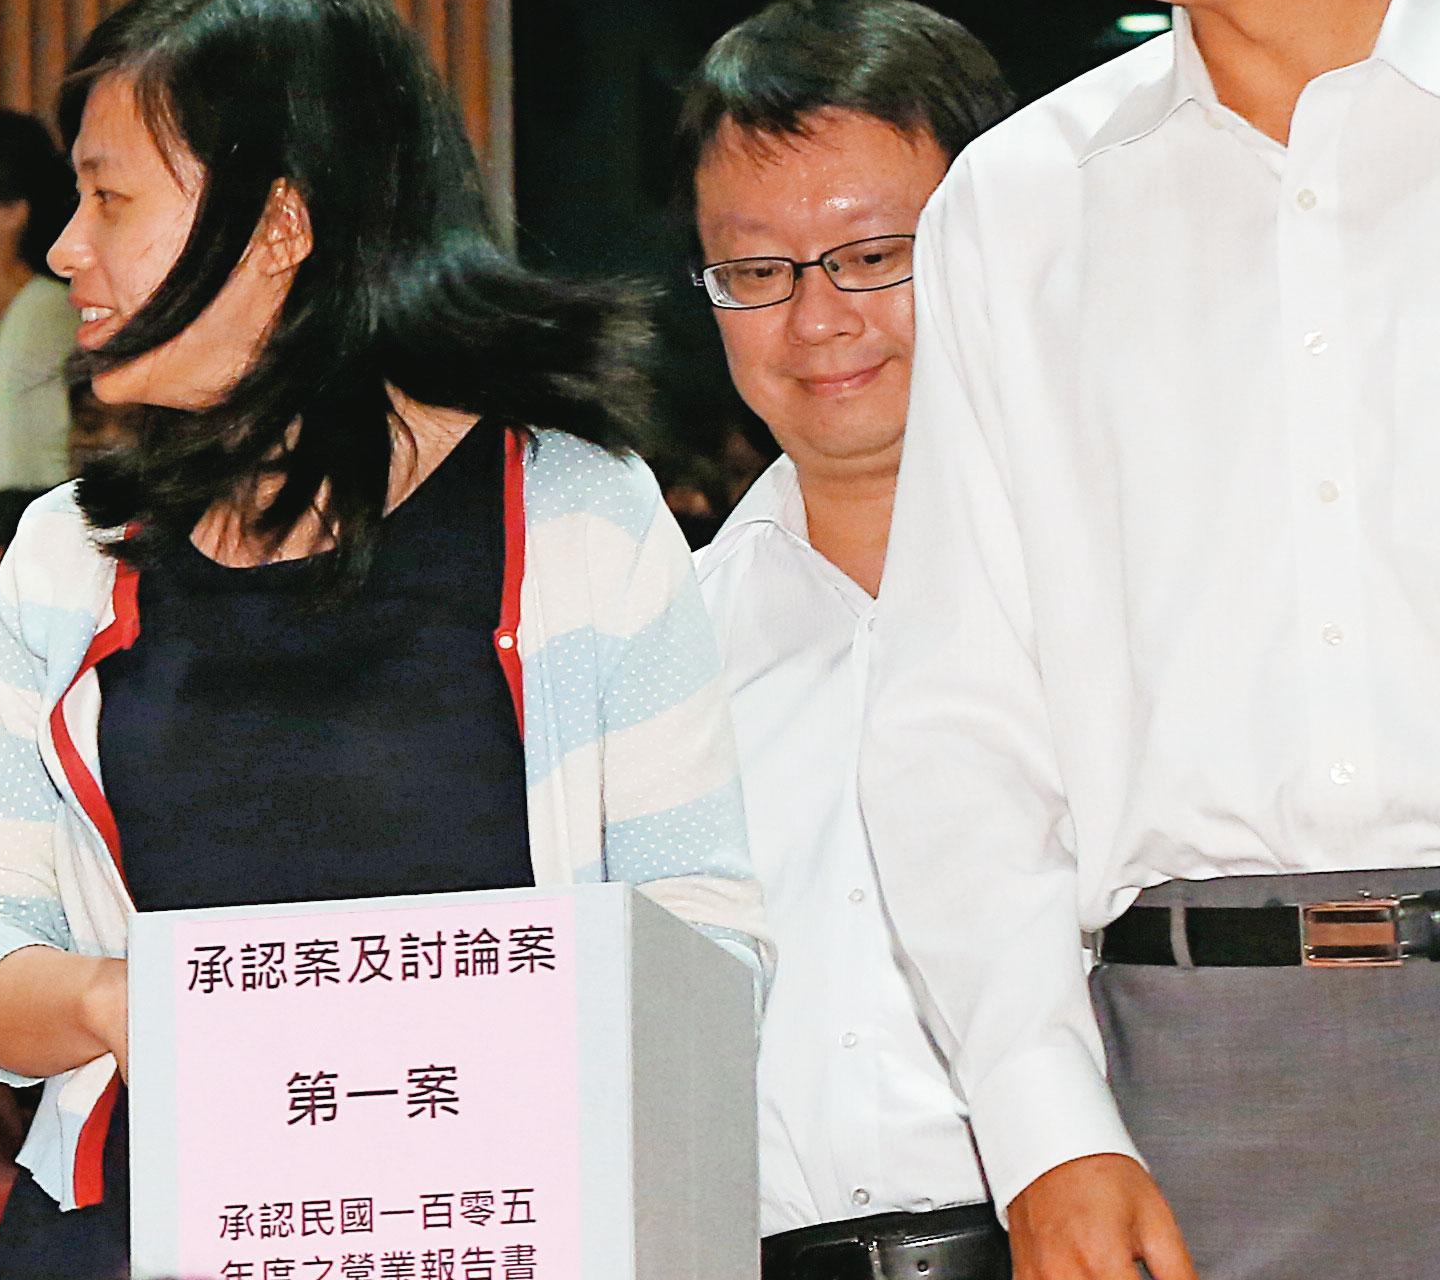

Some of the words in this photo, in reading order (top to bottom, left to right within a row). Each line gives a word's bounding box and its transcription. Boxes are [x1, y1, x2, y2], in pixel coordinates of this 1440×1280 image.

[186, 924, 557, 995] 承認案及討論案
[285, 1063, 460, 1127] 第一案
[218, 1187, 537, 1242] 承認民國一百零五
